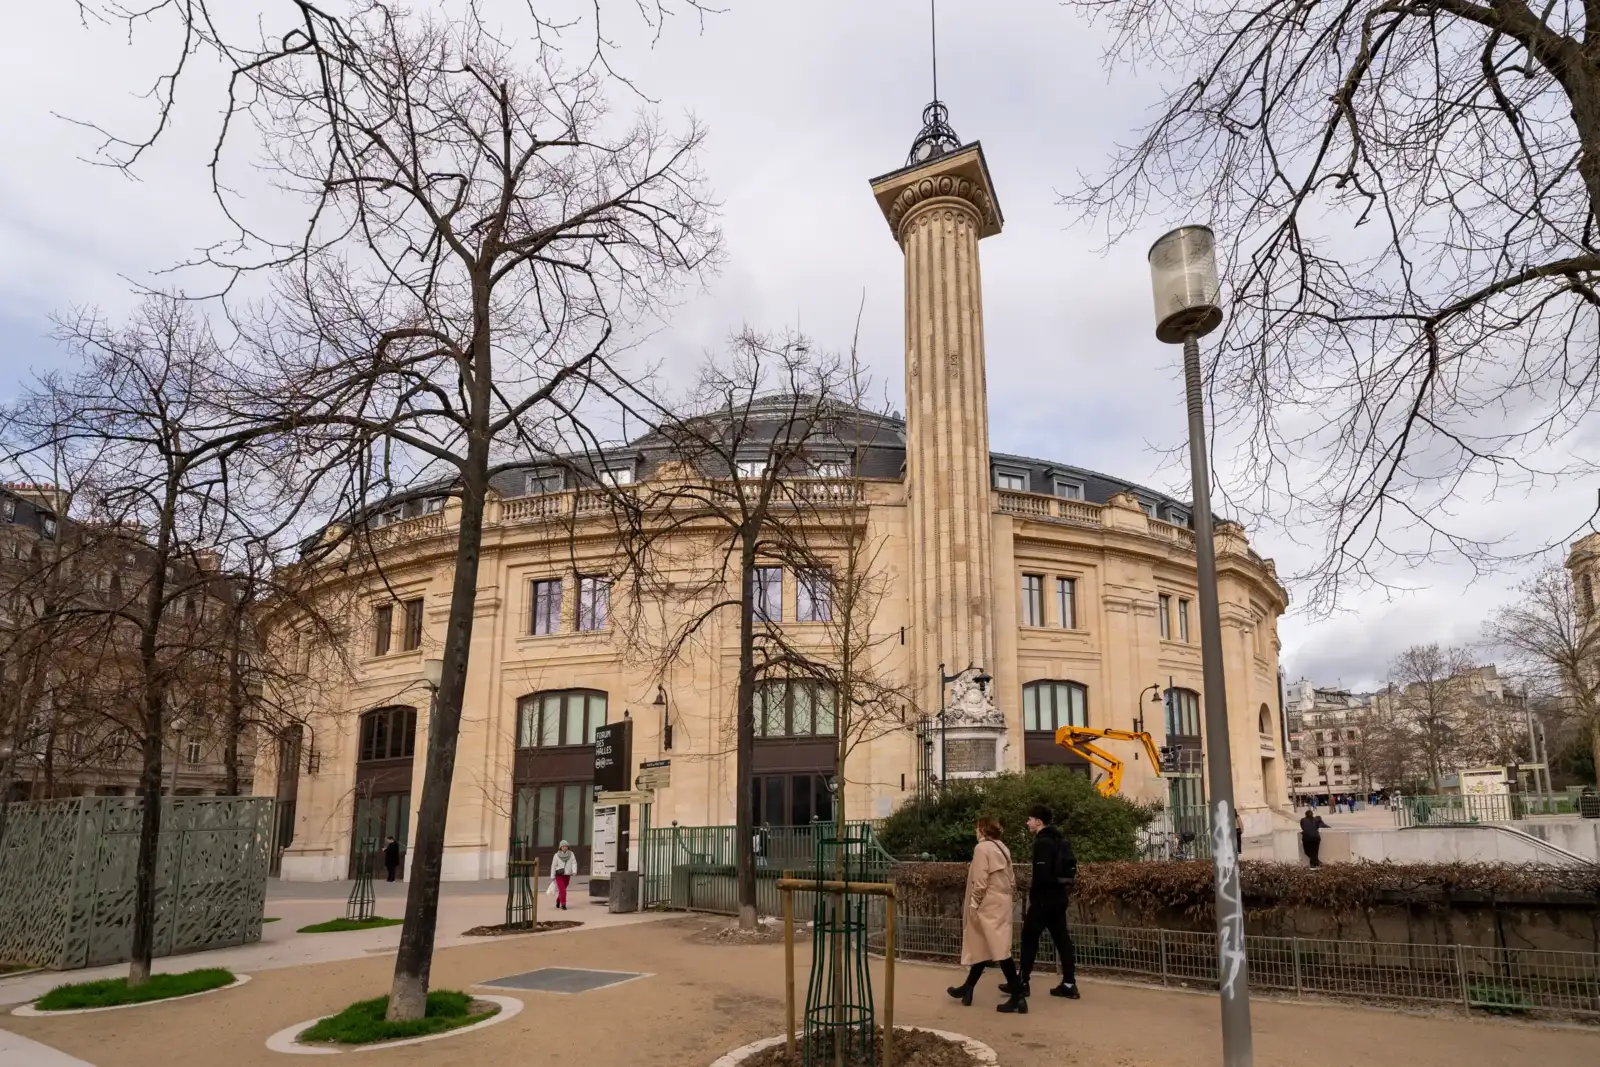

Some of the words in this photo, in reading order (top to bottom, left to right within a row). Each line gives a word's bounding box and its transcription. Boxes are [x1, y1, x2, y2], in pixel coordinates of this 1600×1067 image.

[597, 730, 611, 739] FORUM
[596, 739, 604, 748] DES
[596, 746, 612, 756] HALLES
